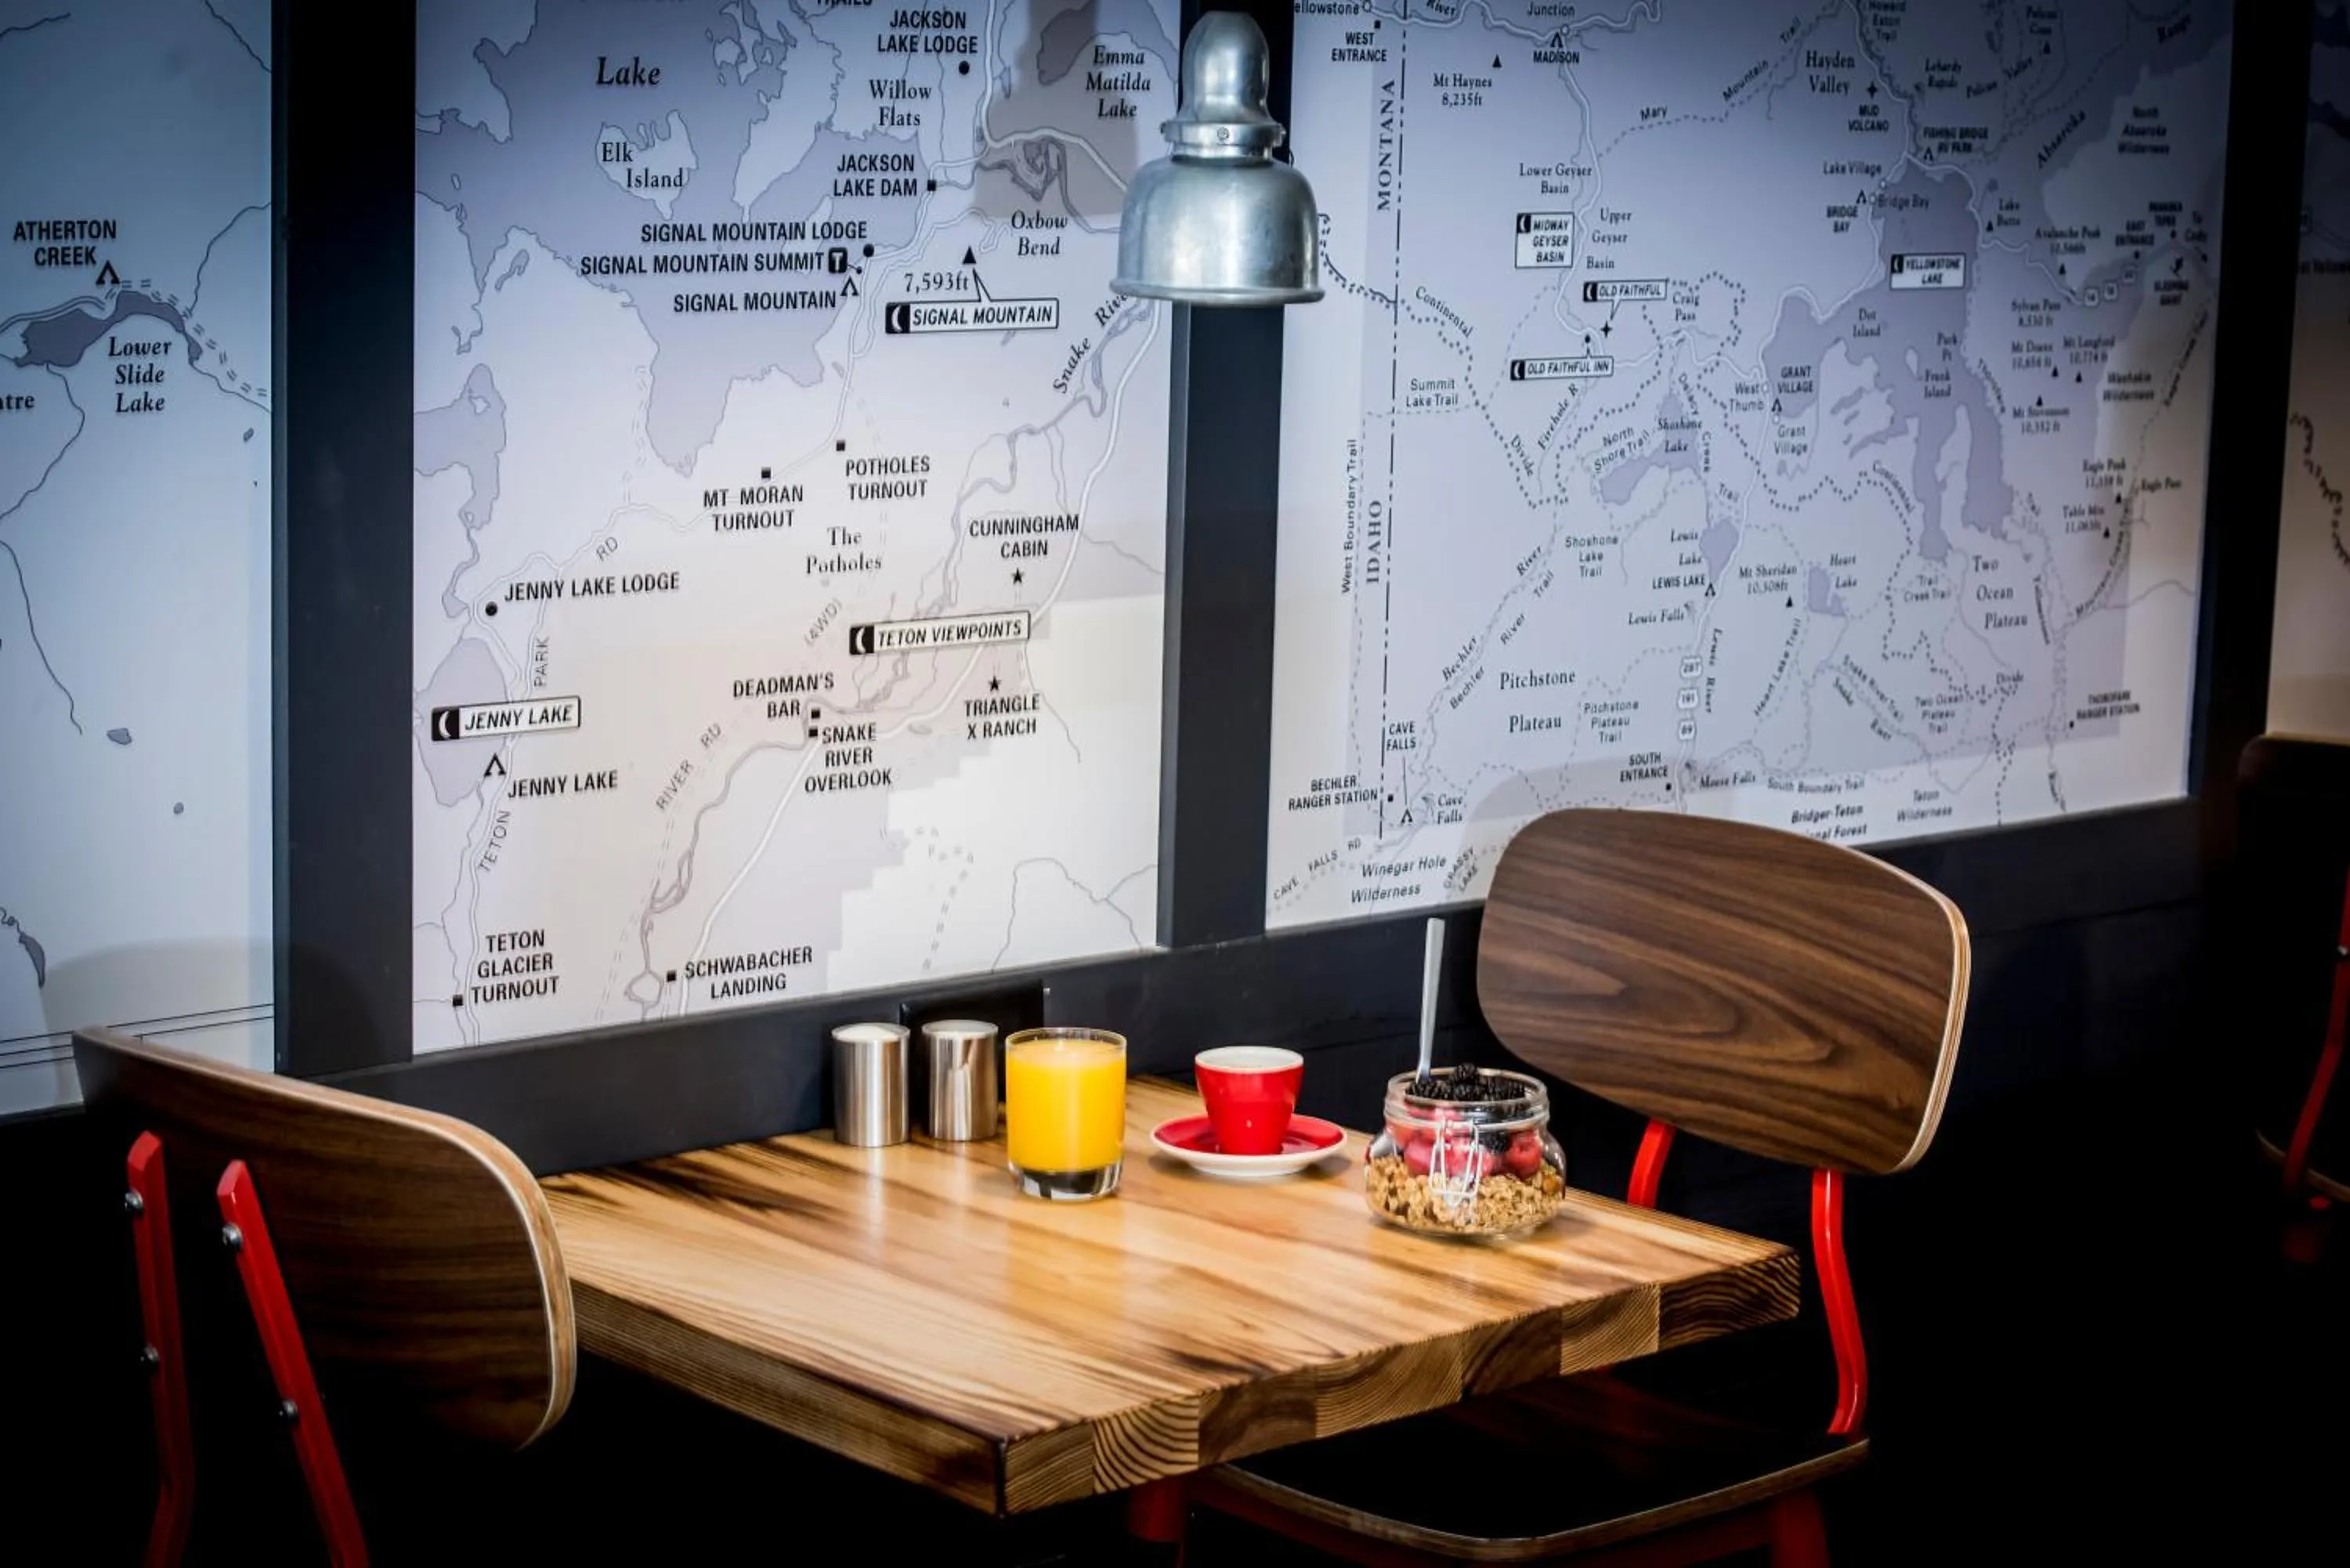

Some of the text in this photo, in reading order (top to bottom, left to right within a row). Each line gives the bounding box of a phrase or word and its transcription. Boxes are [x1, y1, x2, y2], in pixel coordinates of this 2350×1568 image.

[1294, 2, 1359, 15] ellowstone
[890, 10, 967, 29] JACKSON
[877, 35, 978, 53] LAKE LODGE
[1346, 32, 1375, 45] WEST
[1093, 45, 1144, 66] Emma
[1332, 49, 1387, 62] ENTRANCE
[1534, 50, 1579, 63] MADISON
[1806, 50, 1855, 70] Hayden
[595, 56, 661, 85] Lake
[870, 79, 931, 99] Willow
[1086, 72, 1152, 92] Matilda
[1433, 74, 1491, 89] Mt Haynes
[1809, 75, 1850, 96] Valley
[879, 107, 921, 127] Flats
[1098, 99, 1137, 117] Lake
[602, 142, 633, 162] Elk
[1377, 79, 1395, 212] MONTANA
[837, 154, 914, 172] JACKSON
[1519, 163, 1592, 179] Lower Geyser
[627, 168, 683, 188] Island
[833, 179, 917, 197] LAKE DAM
[1542, 181, 1568, 194] Basin
[1010, 210, 1068, 232] Oxbow
[1533, 220, 1569, 231] MIDWAY
[1600, 208, 1632, 224] Upper
[13, 220, 117, 241] ATHERTON
[641, 222, 868, 243] SIGNAL MOUNTAIN LODGE
[1592, 230, 1627, 244] Geyser
[1018, 237, 1061, 256] Bend
[1533, 236, 1568, 247] GEYSER
[34, 247, 96, 266] CREEK
[580, 255, 647, 275] SIGNAL
[653, 253, 749, 273] MOUNTAIN
[754, 252, 824, 272] SUMMIT
[1537, 251, 1564, 263] BASIN
[1586, 257, 1614, 269] Basin
[905, 272, 968, 294] 7,593ft
[1599, 284, 1661, 297] OLD FAITHFUL
[674, 291, 837, 313] SIGNAL MOUNTAIN
[1672, 293, 1699, 306] Craig
[913, 306, 1052, 327] SIGNAL MOUNTAIN
[1415, 287, 1474, 338] Continental
[108, 337, 172, 357] Lower
[1052, 295, 1129, 394] Snake Rive
[115, 364, 164, 385] Slide
[1528, 360, 1609, 374] OLD FAITHFUL INN
[1781, 367, 1811, 378] GRANT
[1410, 378, 1455, 391] Summit
[1777, 381, 1813, 393] VILLAGE
[116, 392, 165, 413] Lake
[1406, 394, 1458, 407] Lake Trail
[845, 456, 931, 476] POTHOLES
[703, 485, 803, 508] MT MORAN
[849, 479, 927, 500] TURNOUT
[712, 510, 794, 531] TURNOUT
[969, 514, 1079, 537] CUNNINGHAM
[827, 526, 862, 547] The
[1366, 500, 1382, 584] IDAHO
[596, 537, 618, 561] RD
[1001, 540, 1048, 559] CABIN
[805, 552, 882, 575] Potholes
[504, 573, 680, 602] JENNY LAKE LODGE
[1652, 574, 1705, 589] LEWIS LAKE
[878, 620, 1021, 647] TETON VIEWPOINTS
[533, 636, 550, 687] PARK
[732, 672, 834, 698] DEADMAN'S
[1500, 669, 1575, 690] Pitchstone
[767, 699, 801, 719] BAR
[964, 694, 1040, 717] TRIANGLE
[465, 704, 573, 730] JENNY LAKE
[1509, 714, 1561, 733] Plateau
[822, 722, 877, 744] SNAKE
[967, 719, 1036, 739] X RANCH
[1389, 721, 1415, 735] CAVE
[1386, 738, 1416, 752] FALLS
[655, 723, 721, 810] RIVER RD
[825, 746, 873, 768] RIVER
[1629, 752, 1661, 766] SOUTH
[508, 770, 618, 798] JENNY LAKE
[804, 768, 892, 793] OVERLOOK
[1311, 775, 1357, 792] BECHLER
[1620, 766, 1668, 782] ENTRANCE
[1289, 789, 1378, 811] RANGER STATION
[478, 810, 512, 872] TETON
[1361, 855, 1446, 879] Winegar Hole
[1350, 883, 1421, 903] Wilderness
[486, 929, 545, 953] TETON
[477, 952, 553, 979] GLACIER
[685, 946, 813, 979] SCHWABACHER
[470, 976, 560, 1004] TURNOUT
[710, 973, 786, 1000] LANDING
